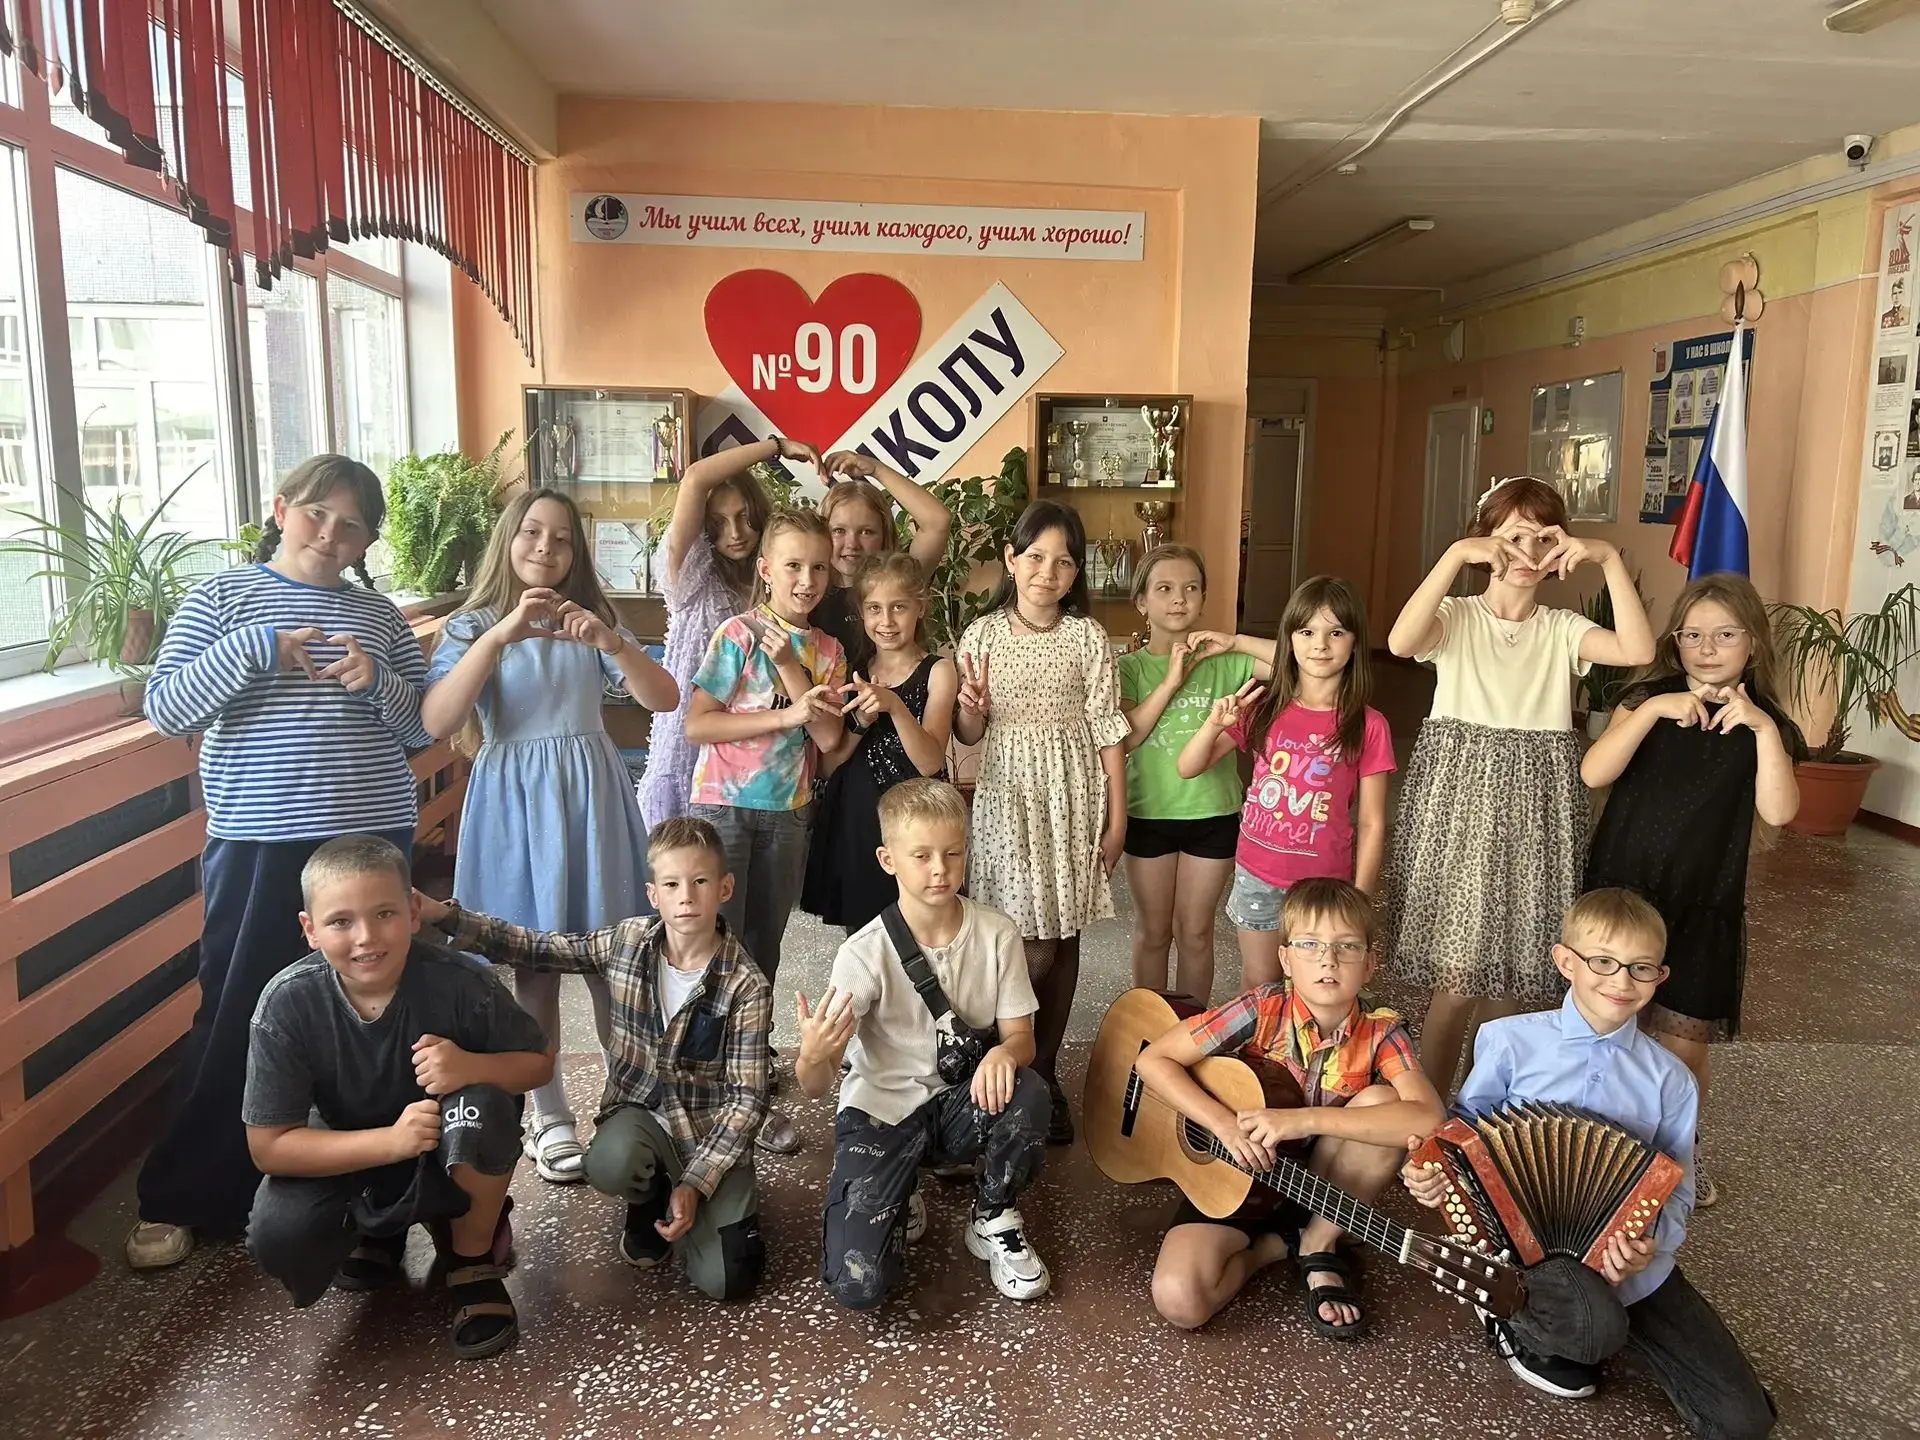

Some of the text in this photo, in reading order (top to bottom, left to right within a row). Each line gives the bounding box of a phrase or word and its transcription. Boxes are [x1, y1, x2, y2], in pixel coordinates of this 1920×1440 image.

[639, 205, 1131, 252] Мы учим всех, учим каждого, учим хорошо!
[1710, 340, 1733, 356] ШКОЛ
[445, 1096, 480, 1122] alo
